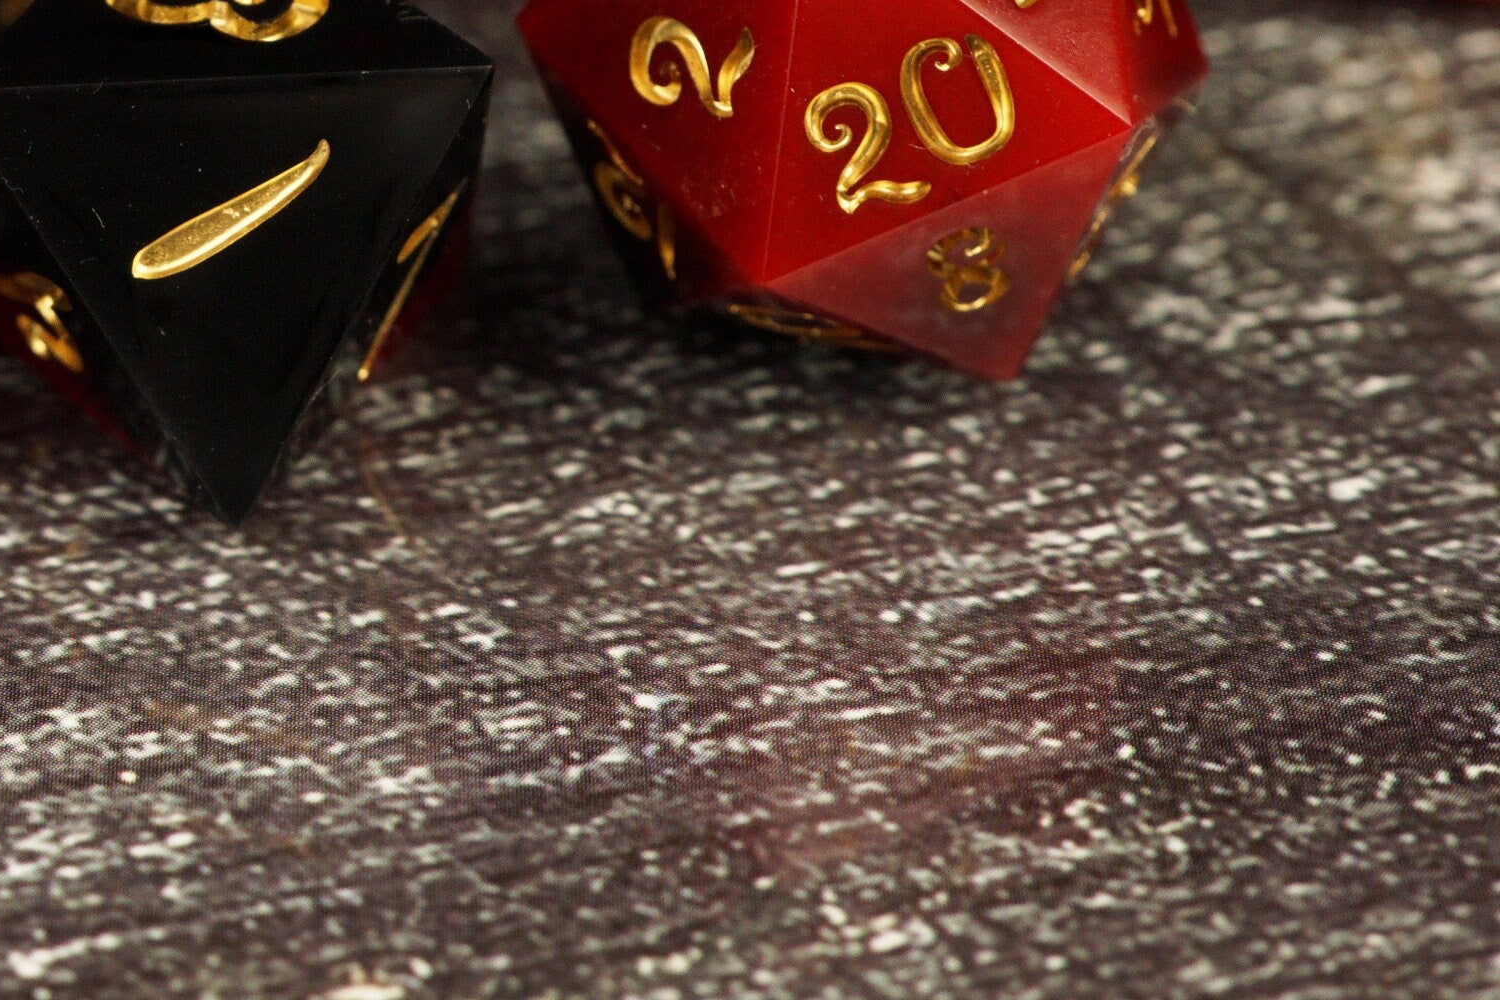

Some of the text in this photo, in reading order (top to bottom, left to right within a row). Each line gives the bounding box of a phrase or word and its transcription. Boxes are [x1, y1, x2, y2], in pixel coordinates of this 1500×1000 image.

[628, 15, 755, 118] 2
[803, 34, 1016, 214] 20
[131, 138, 332, 281] 1
[926, 226, 1009, 313] 8
